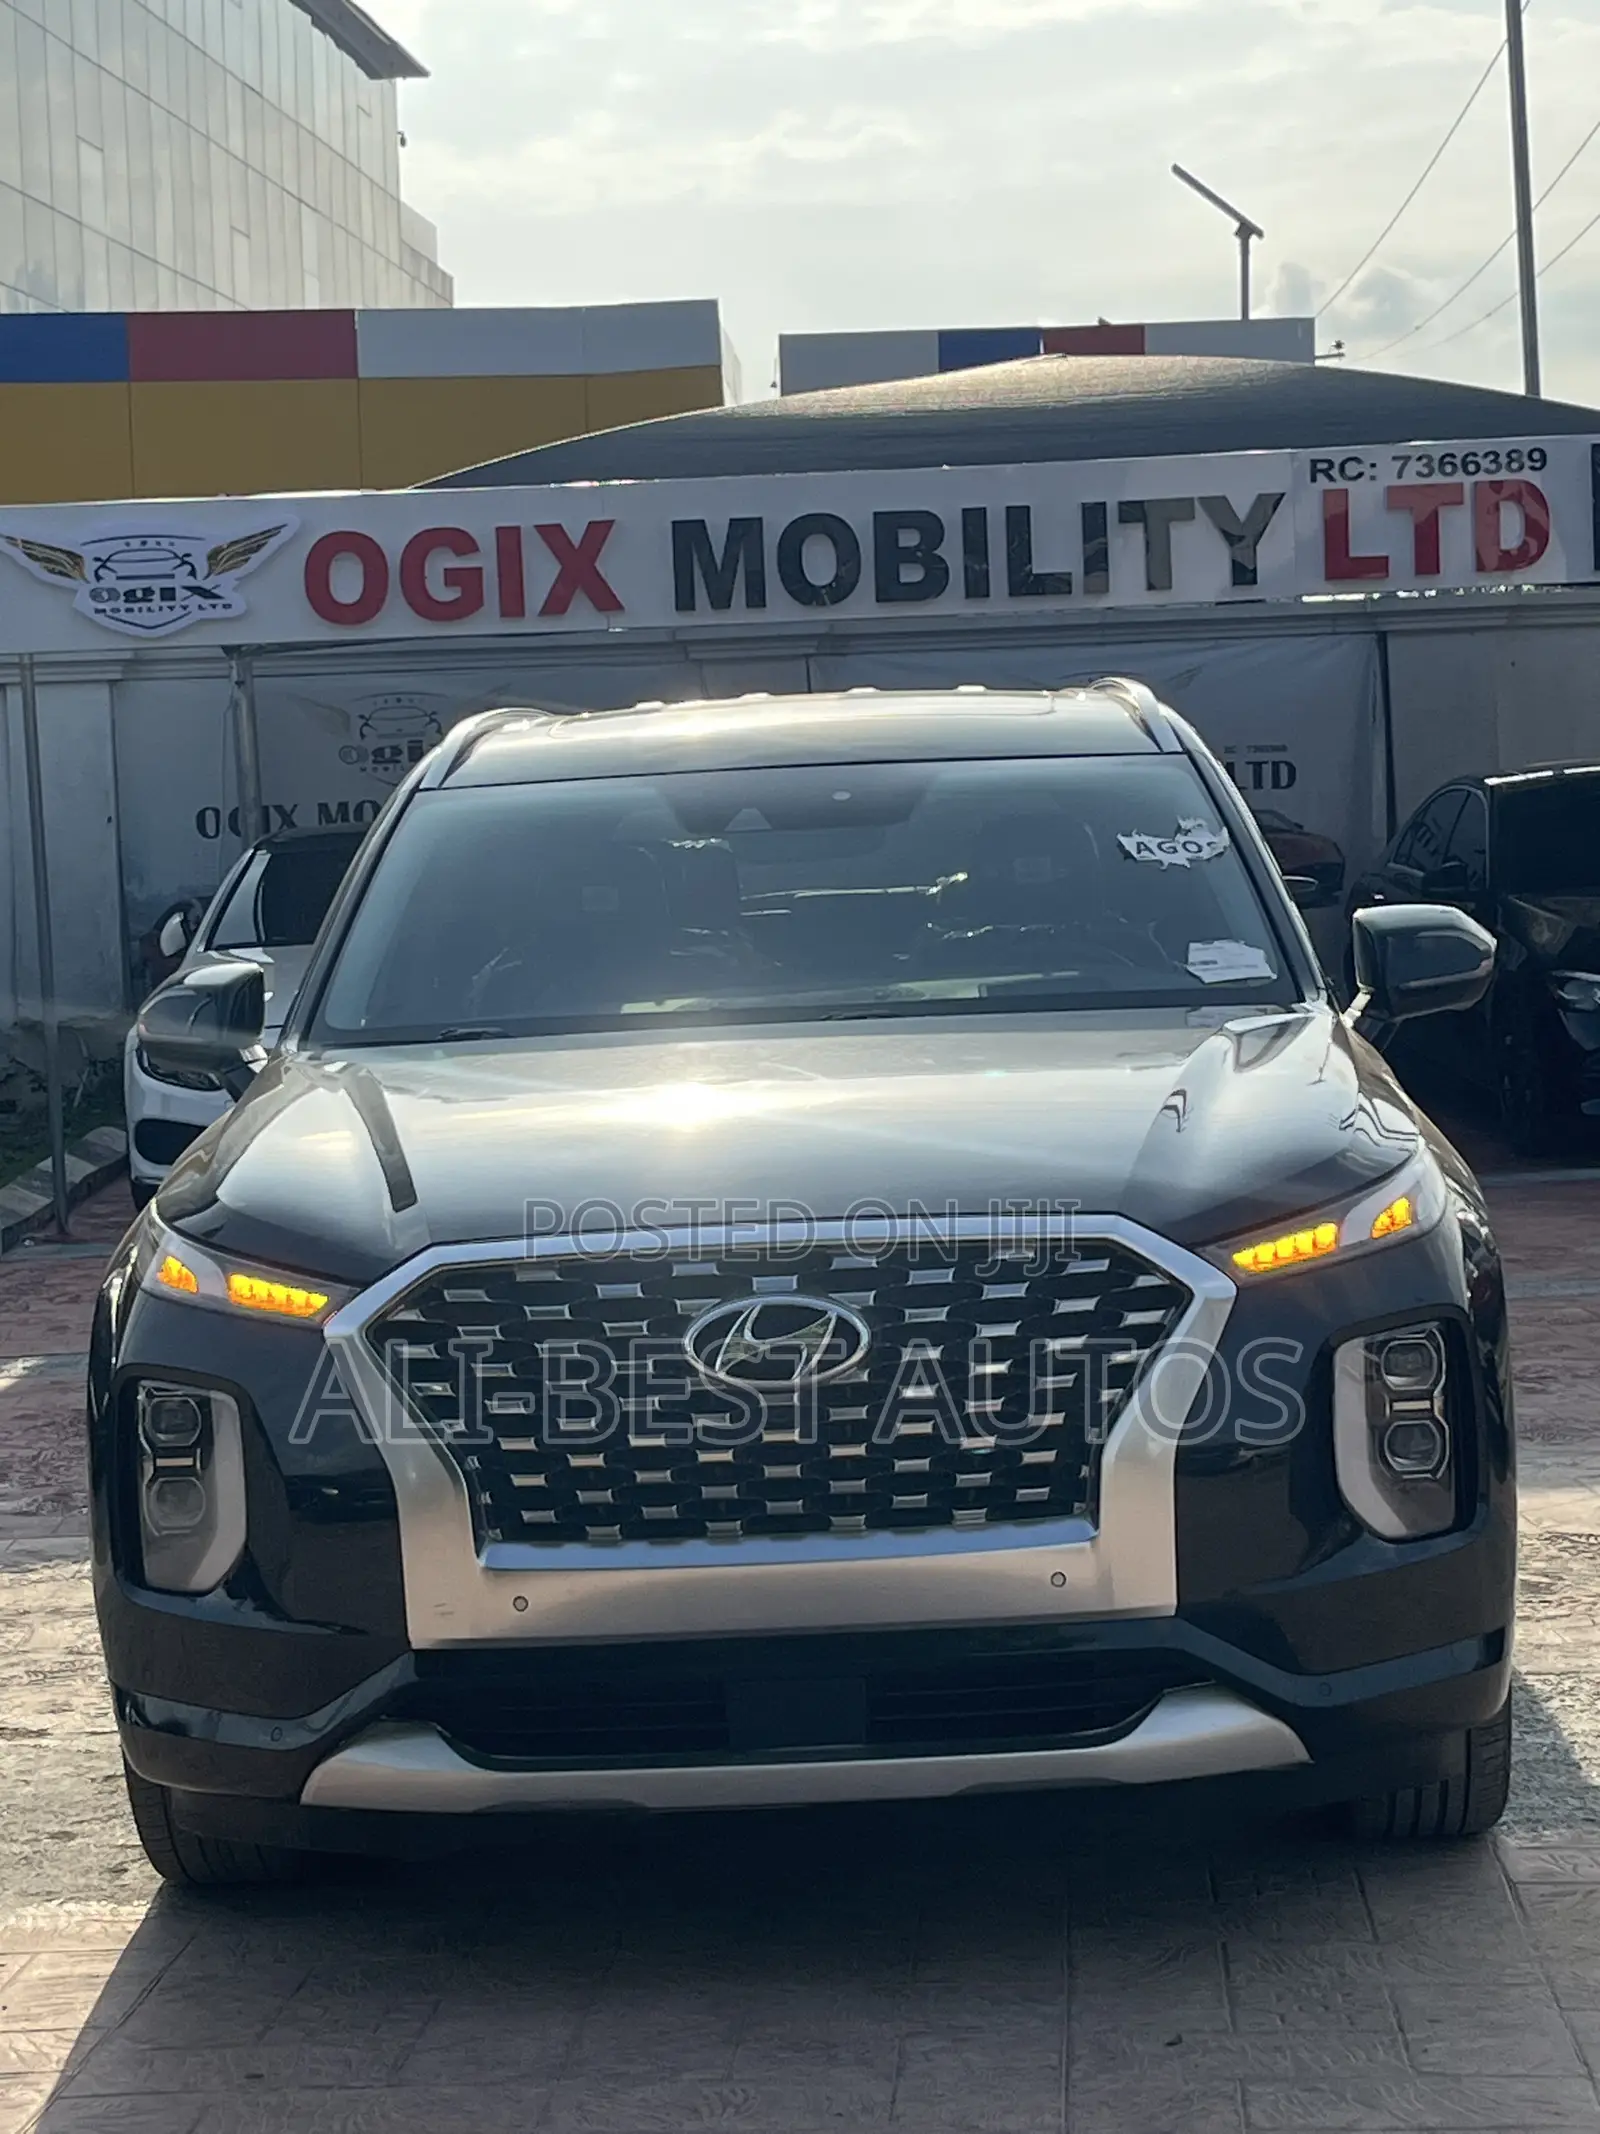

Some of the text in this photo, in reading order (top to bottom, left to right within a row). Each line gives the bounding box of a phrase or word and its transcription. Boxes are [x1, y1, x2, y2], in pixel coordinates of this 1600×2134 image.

[1309, 448, 1547, 483] RC: 7366389
[304, 519, 625, 625] OGIX
[671, 492, 1286, 611] MOBILITY
[1323, 479, 1550, 581] LTD
[94, 603, 189, 614] MOBILITY
